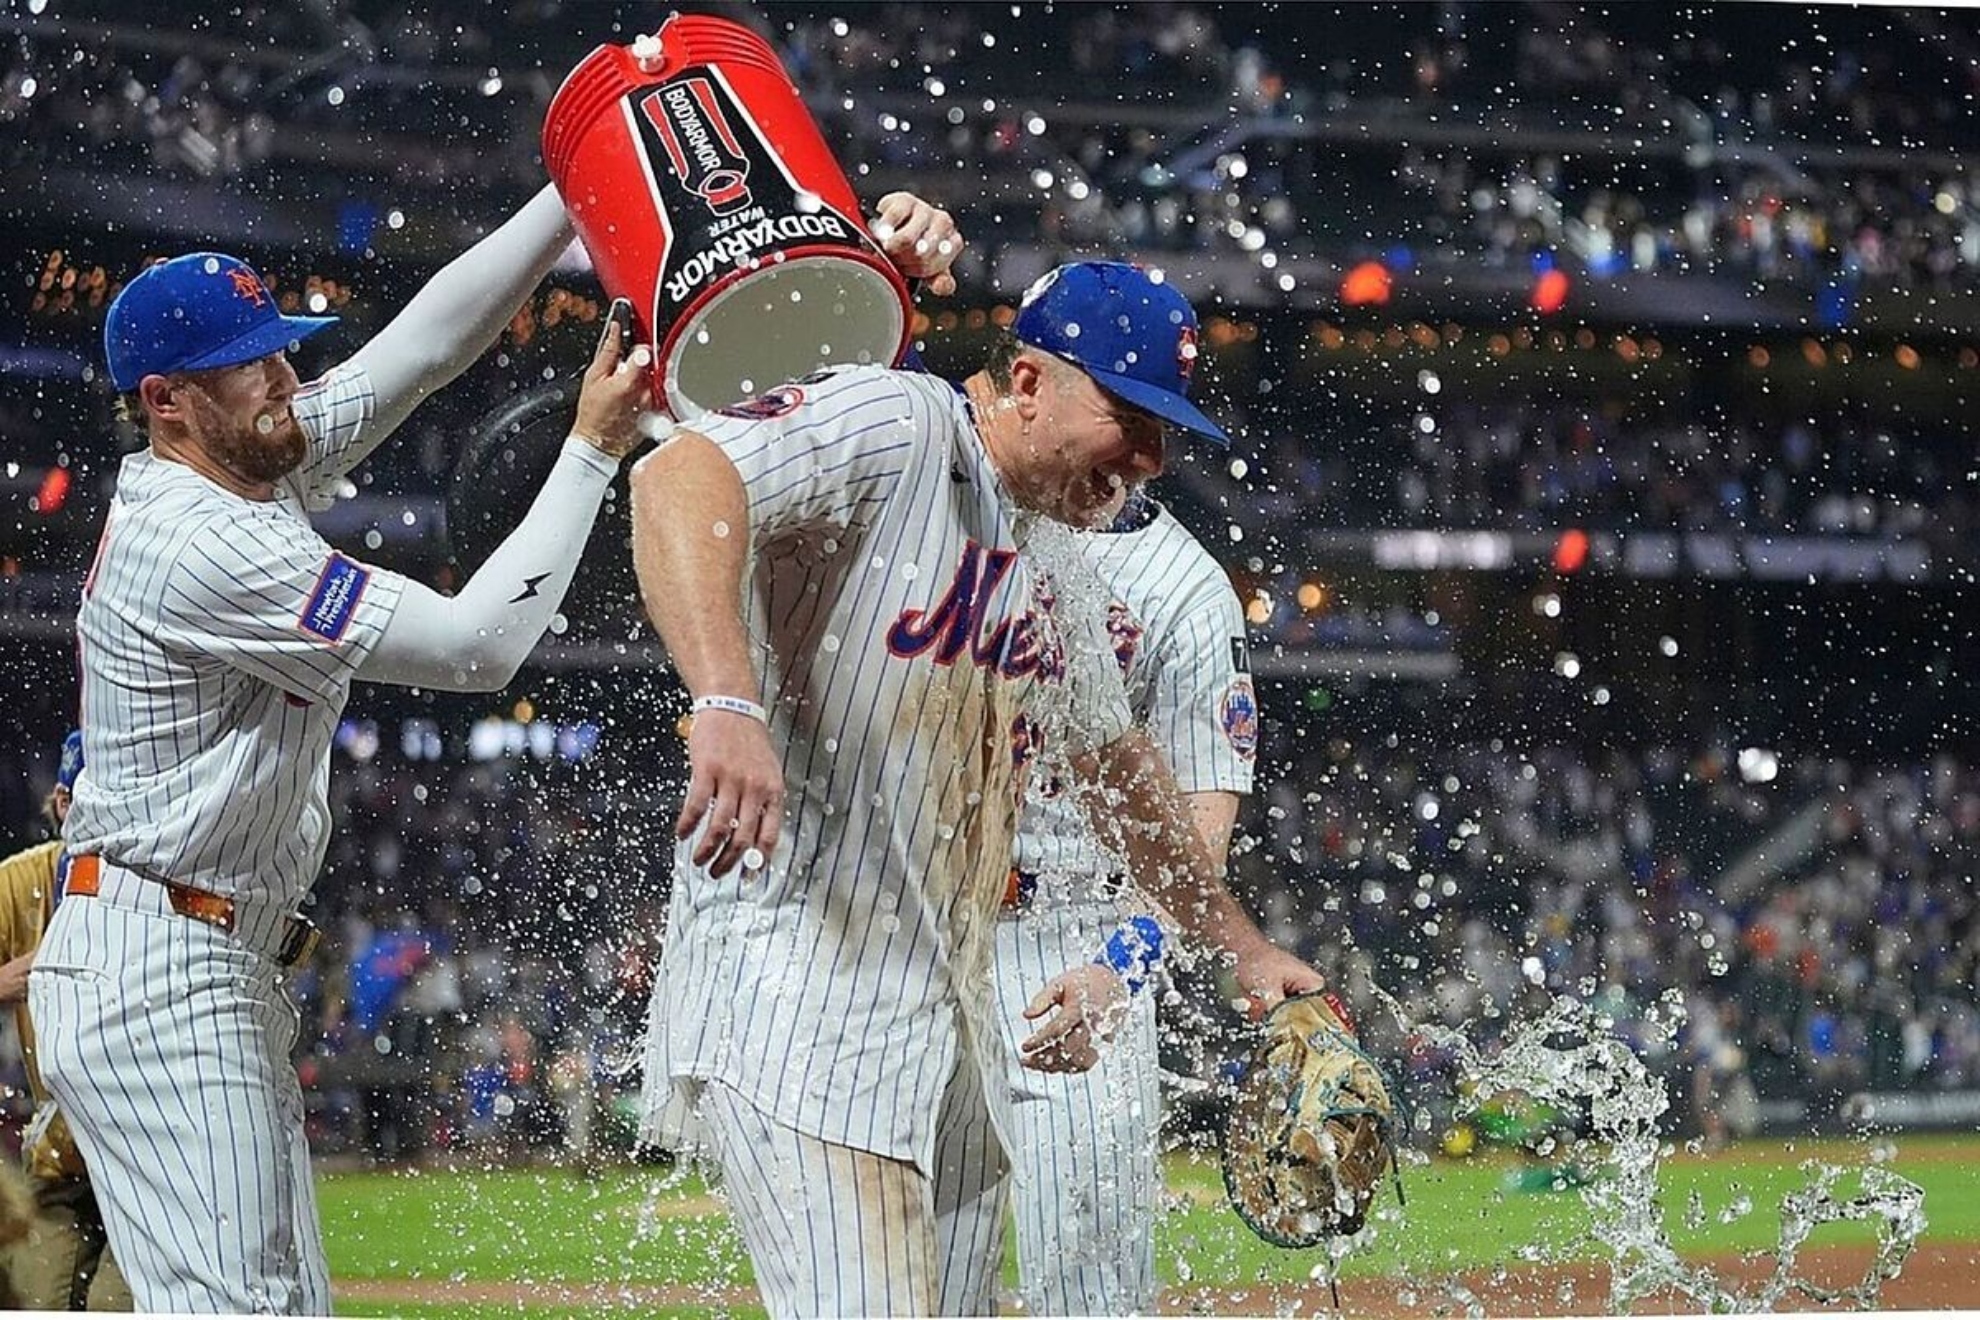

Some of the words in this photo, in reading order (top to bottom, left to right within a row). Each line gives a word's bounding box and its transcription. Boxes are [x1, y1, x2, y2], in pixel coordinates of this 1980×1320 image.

[665, 86, 721, 172] BODYARMOR
[665, 215, 848, 302] BODYARMOR
[708, 206, 766, 237] WATER
